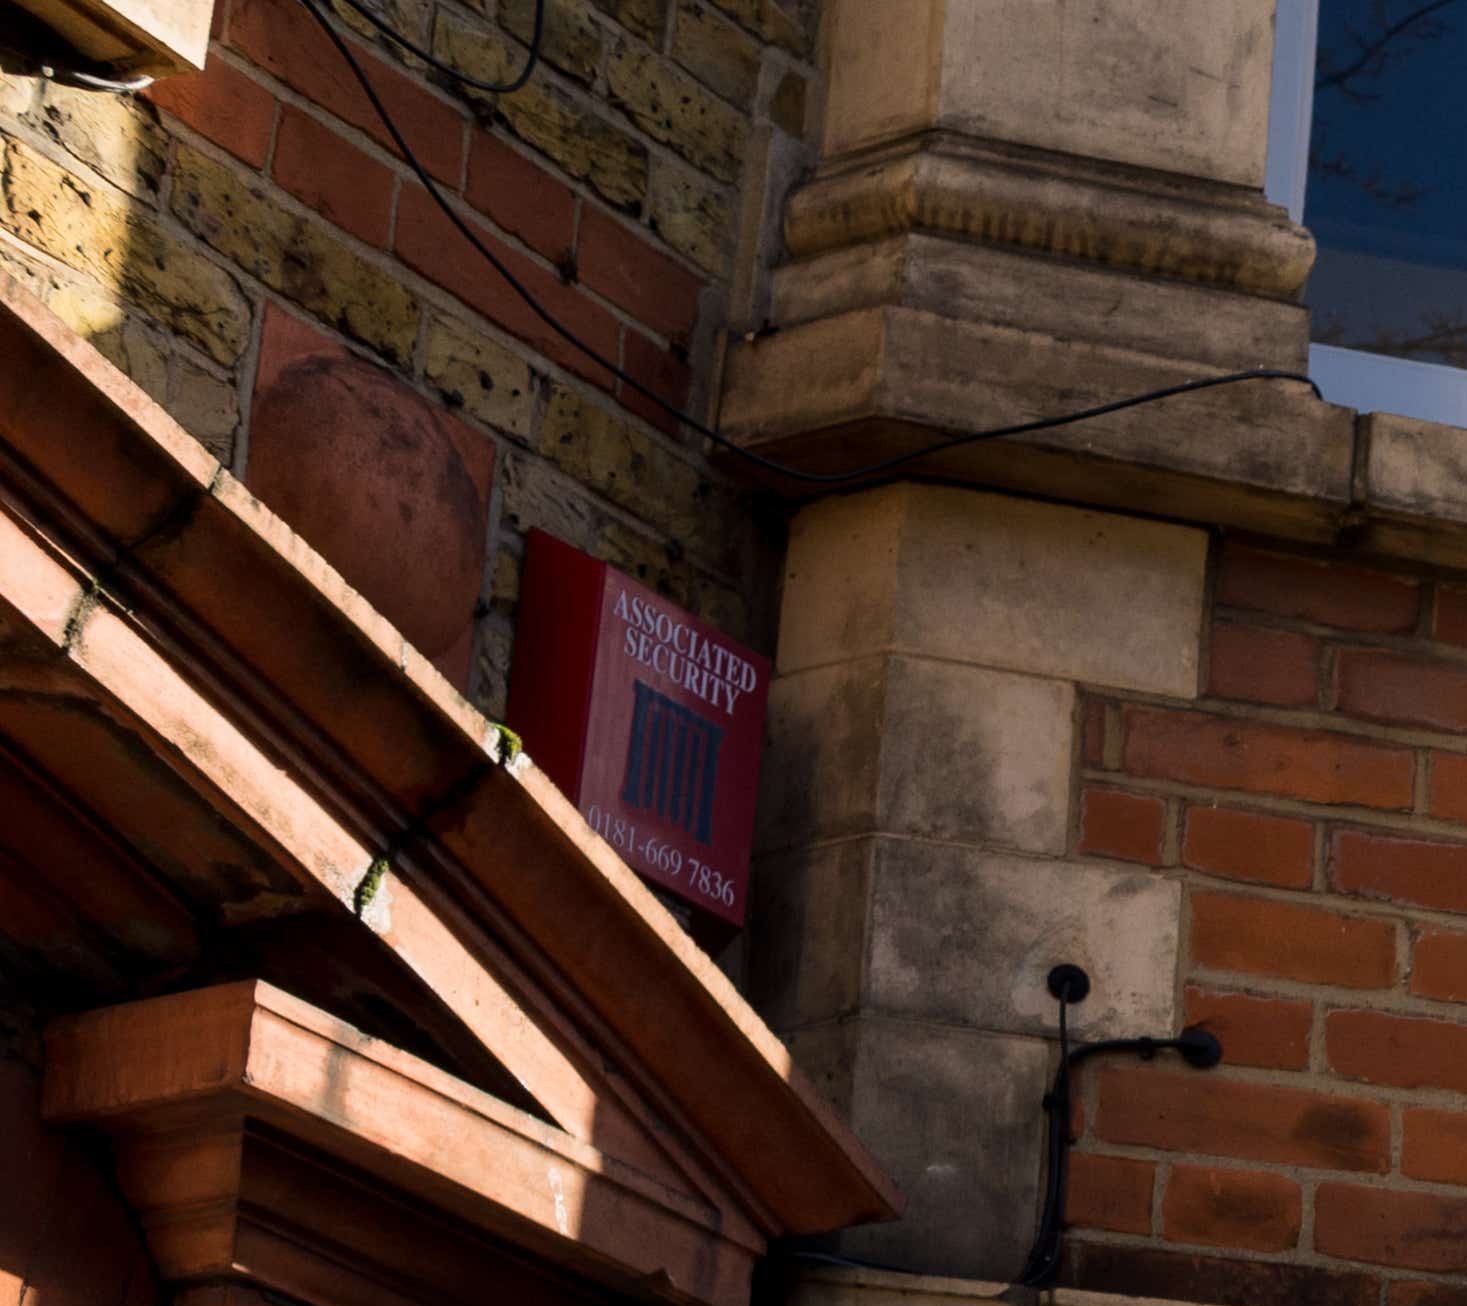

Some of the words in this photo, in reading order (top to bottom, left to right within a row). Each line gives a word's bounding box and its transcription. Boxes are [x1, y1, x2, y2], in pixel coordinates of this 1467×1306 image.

[614, 589, 757, 692] ASSOCIATED
[624, 627, 741, 715] SECURITY
[588, 805, 682, 875] 0181-669
[688, 858, 735, 906] 7836
